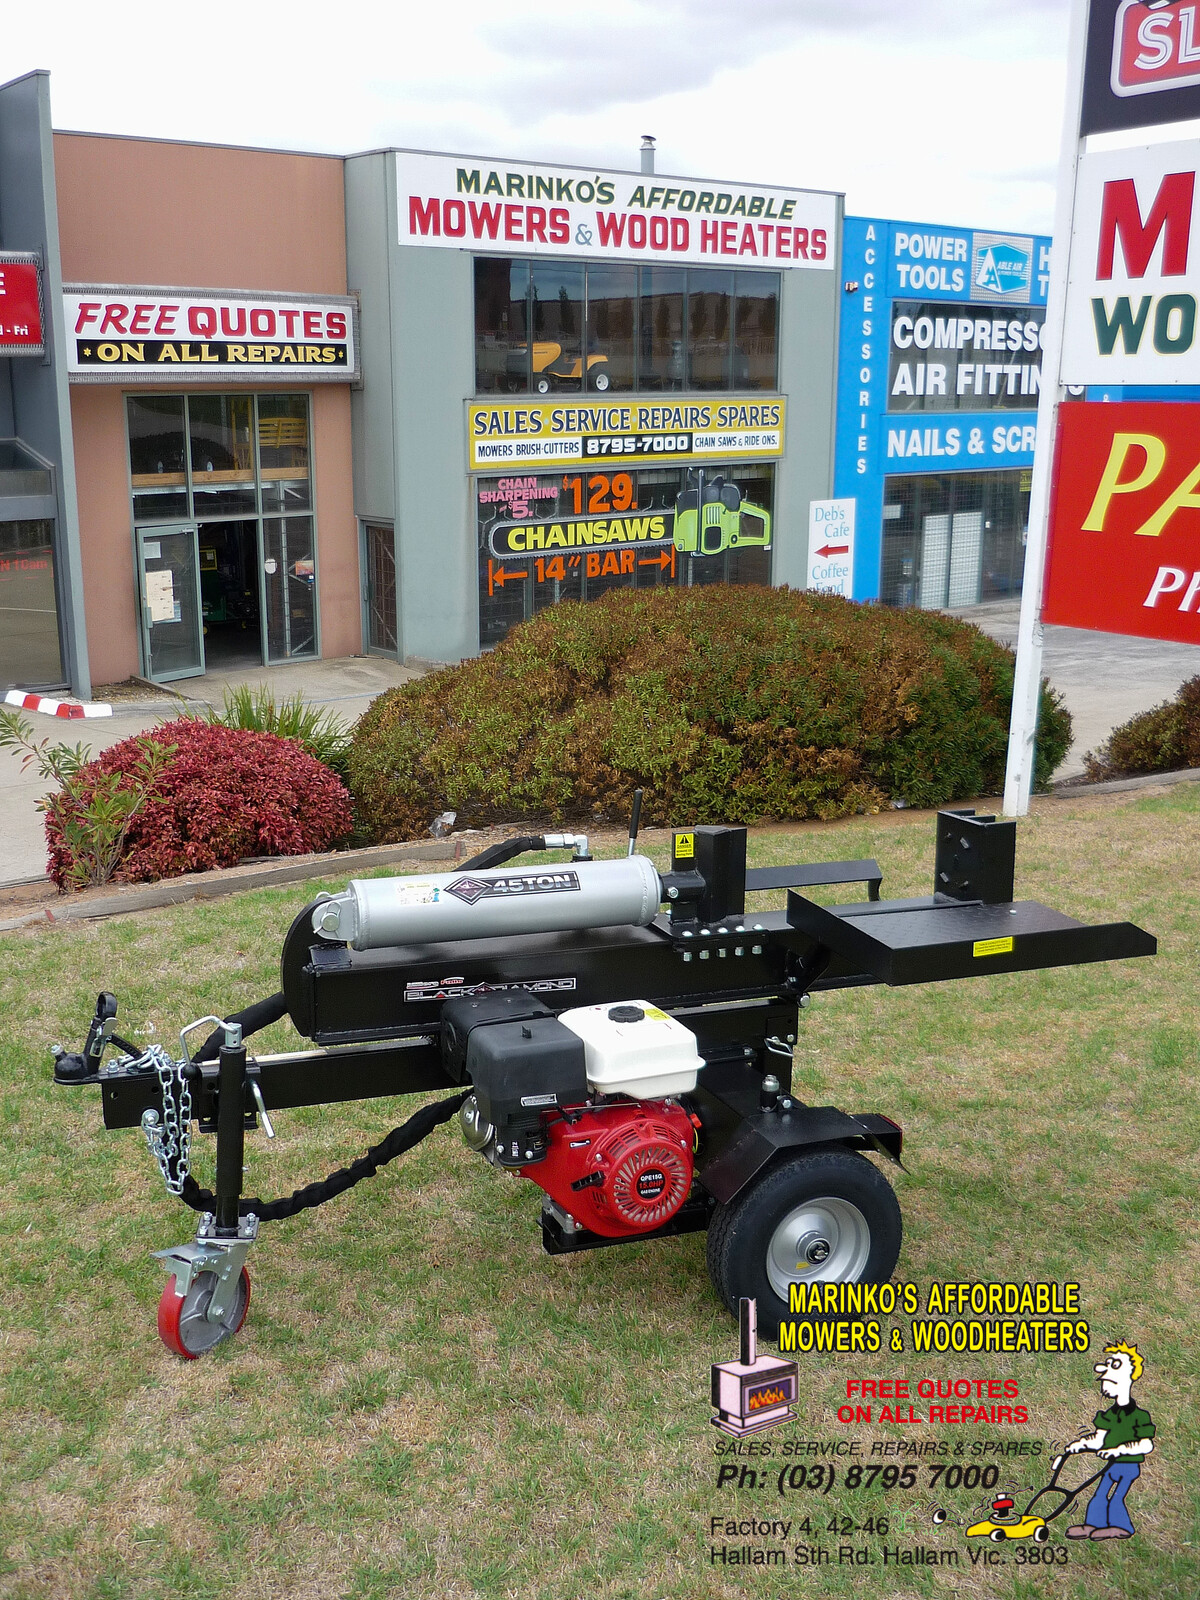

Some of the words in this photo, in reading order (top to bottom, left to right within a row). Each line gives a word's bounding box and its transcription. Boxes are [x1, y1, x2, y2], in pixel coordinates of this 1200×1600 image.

[456, 168, 615, 205] MARINKO'S
[627, 186, 797, 221] AFFORDABLE
[408, 196, 570, 244] MOWERS
[575, 223, 593, 246] &
[595, 211, 690, 252] WOOD
[701, 220, 827, 261] HEATERS
[894, 232, 968, 262] POWER
[997, 261, 1012, 270] ABLE
[1012, 262, 1023, 271] AIR
[896, 264, 965, 292] TOOLS
[14, 325, 29, 335] Fri
[74, 302, 181, 336] FREE
[187, 306, 347, 339] QUOTES
[97, 343, 145, 362] ON
[157, 343, 219, 362] ALL
[227, 345, 337, 363] REPAIRS
[892, 363, 946, 396] AIR
[474, 410, 543, 435] SALES
[551, 408, 631, 433] SERVICE
[638, 406, 711, 430] REPAIRS
[717, 405, 780, 427] SPARES
[478, 445, 513, 458] MOWERS
[586, 436, 689, 454] 8795-7000
[695, 437, 716, 448] CHAIN
[718, 436, 737, 447] SAWS
[745, 435, 760, 446] RIDE
[762, 435, 778, 445] ONS.
[887, 428, 960, 458] NAILS
[967, 428, 985, 455] &
[479, 487, 558, 503] SHARPENING
[498, 477, 537, 490] CHAIN
[815, 505, 845, 522] Deb's
[507, 516, 665, 551] CHAINSAWS
[824, 522, 850, 538] Cafe
[586, 550, 636, 578] BAR
[812, 563, 849, 580] Coffee
[493, 874, 572, 892] 45TON
[407, 988, 475, 1000] BLACK
